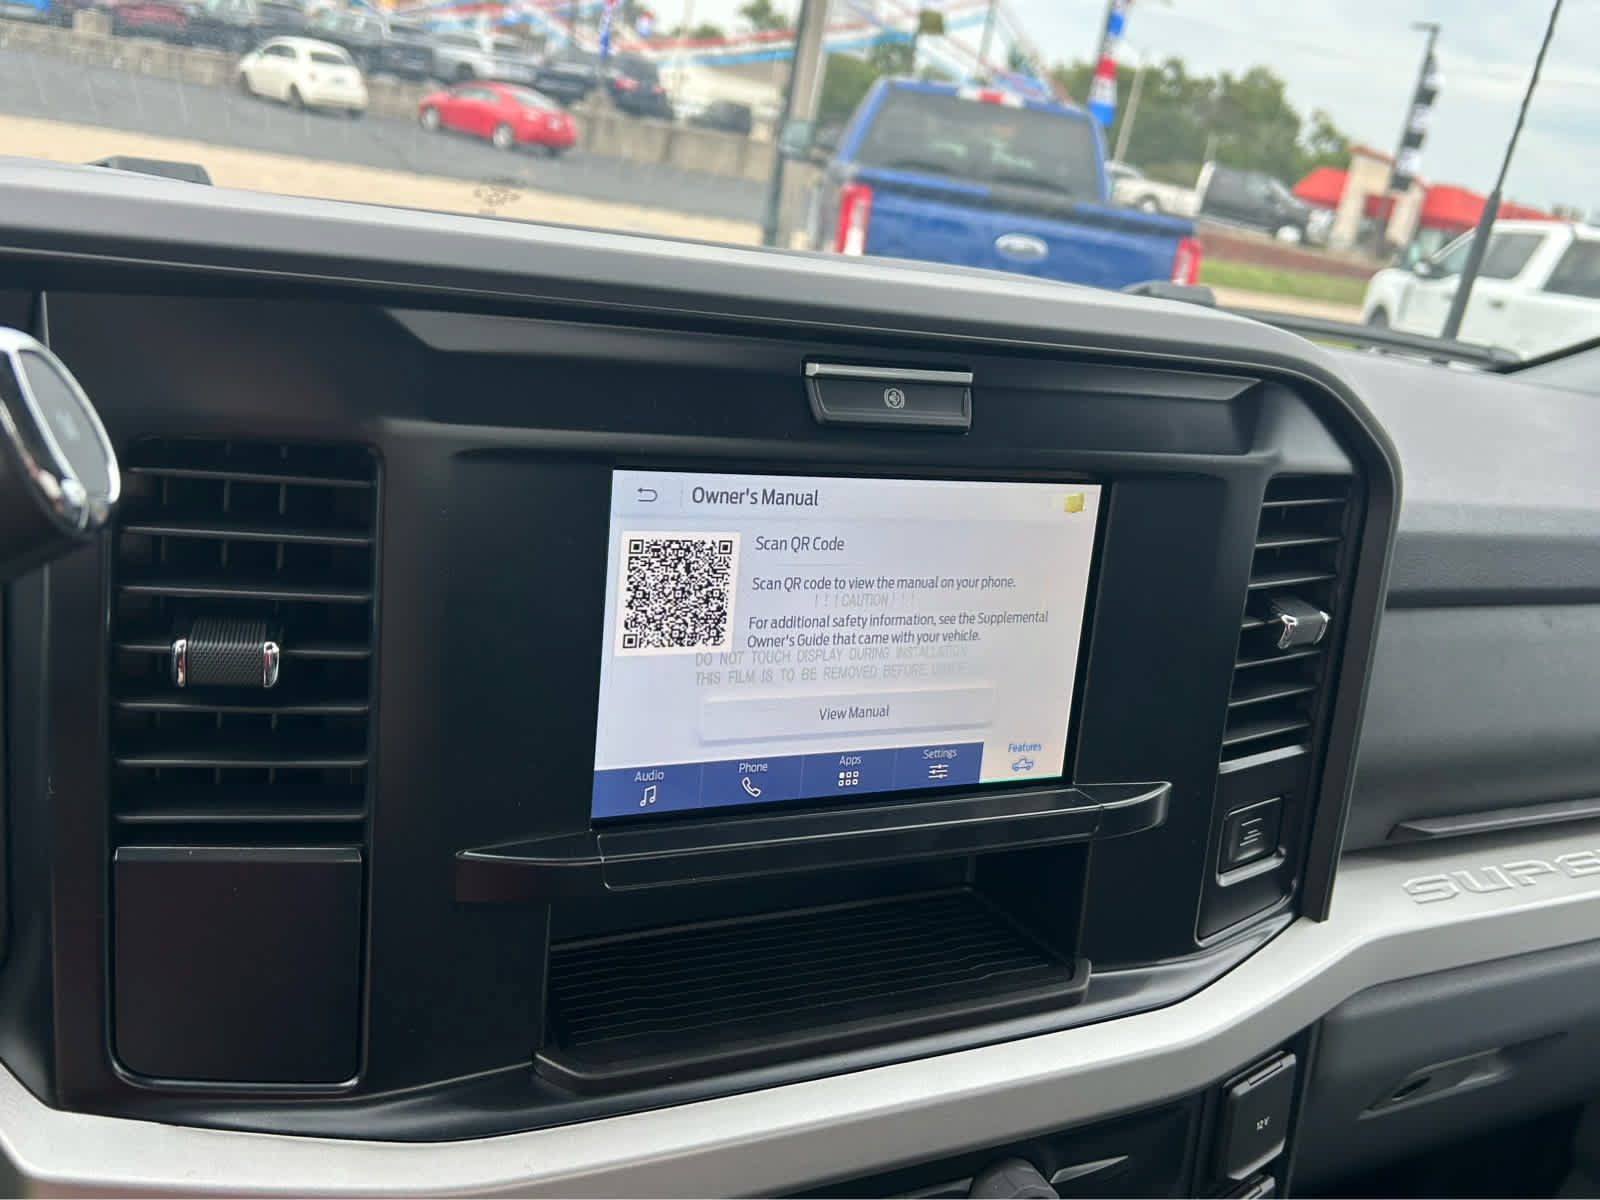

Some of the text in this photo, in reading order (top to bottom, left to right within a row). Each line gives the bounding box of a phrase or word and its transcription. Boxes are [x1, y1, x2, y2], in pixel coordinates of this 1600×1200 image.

[692, 487, 818, 506] Owner's Manual
[755, 536, 845, 552] Scan QR Code
[752, 575, 1016, 592] Scan QR code to view the manual on your phone.
[841, 593, 889, 607] CAUTION
[749, 610, 1048, 629] For additional safety information, see the Supplemental
[747, 628, 980, 648] Owner's Guide that came with your vehicle.
[696, 651, 713, 667] DO
[720, 650, 745, 665] NOT
[752, 649, 790, 664] TOUCH
[797, 648, 843, 663] DISPLAY
[696, 671, 721, 686] THIS
[728, 669, 755, 685] FILM
[760, 669, 773, 684] IS
[781, 668, 796, 683] TO
[801, 666, 816, 680] BE
[824, 664, 878, 680] REMOVED
[820, 704, 889, 720] View Manual
[923, 748, 958, 761] Settings
[1008, 743, 1042, 754] Features
[738, 762, 768, 774] Phone
[840, 754, 861, 767] Apps
[634, 769, 665, 783] Audio
[1403, 849, 1600, 903] SUPE
